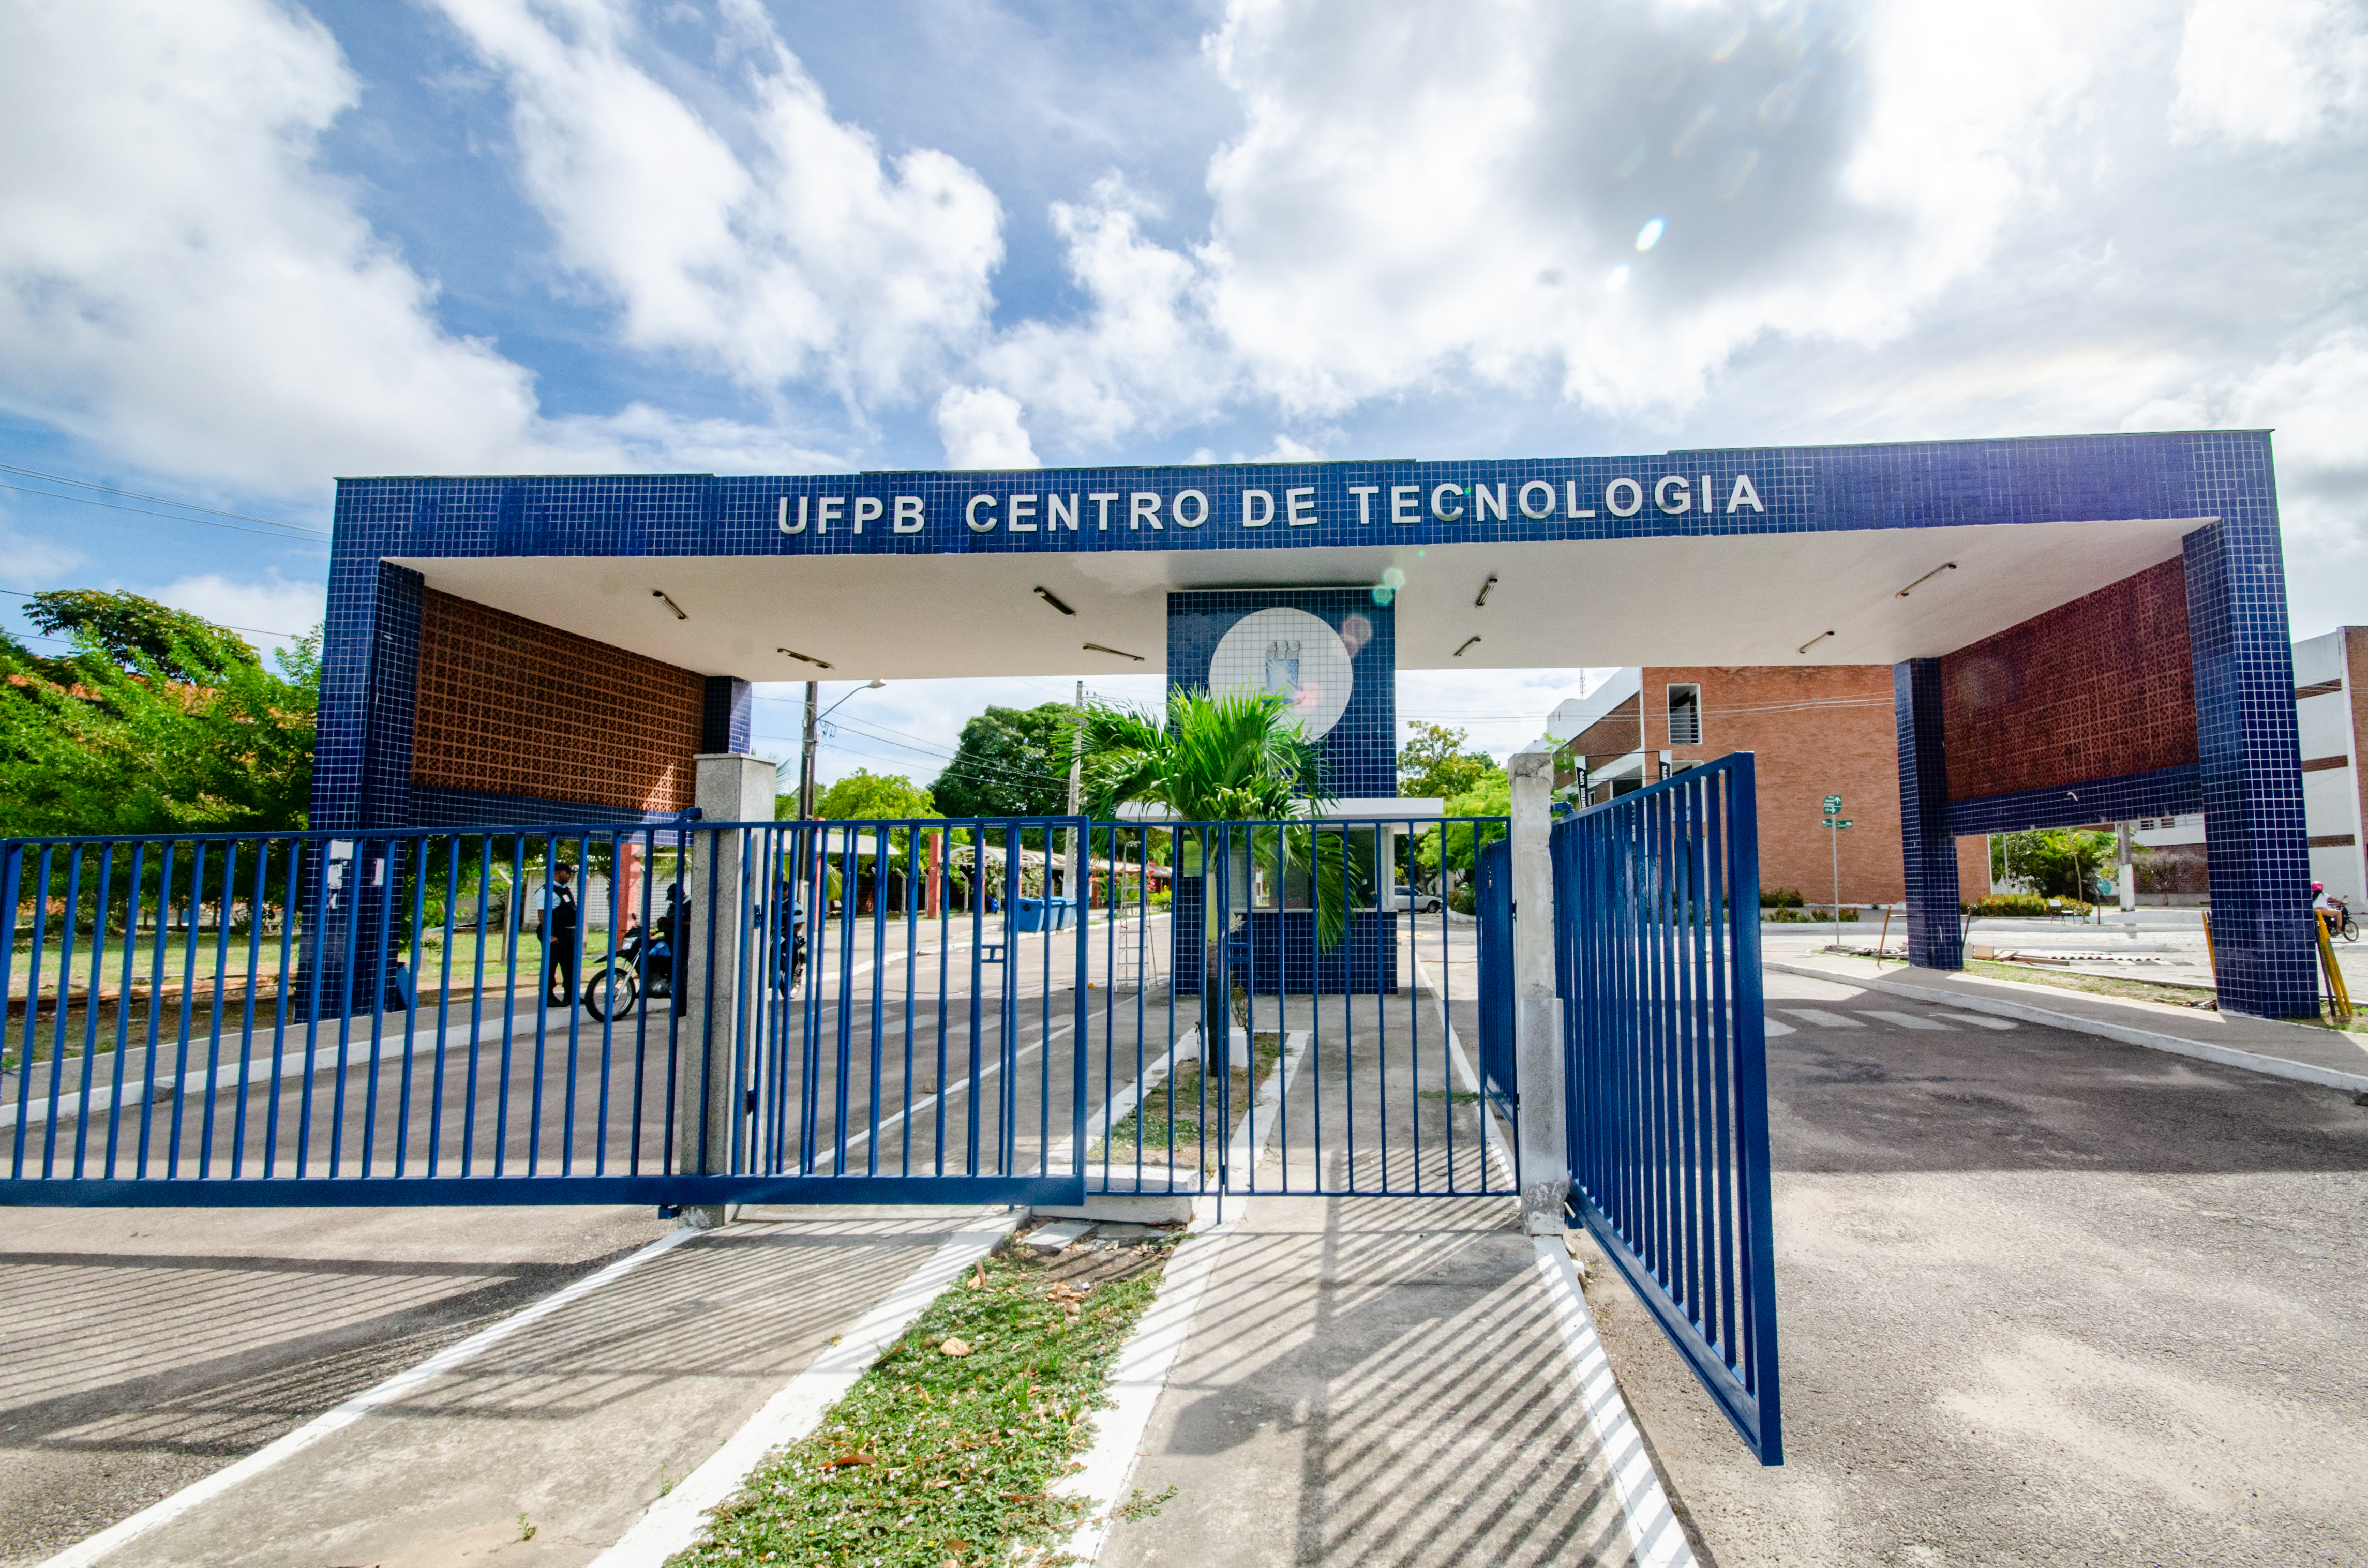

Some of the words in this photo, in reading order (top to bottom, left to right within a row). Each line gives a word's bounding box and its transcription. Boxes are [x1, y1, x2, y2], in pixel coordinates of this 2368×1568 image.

[778, 496, 925, 534] UFPB
[966, 489, 1209, 533] CENTRO
[1242, 487, 1318, 527] DE
[1348, 474, 1765, 524] TECNOLOGIA
